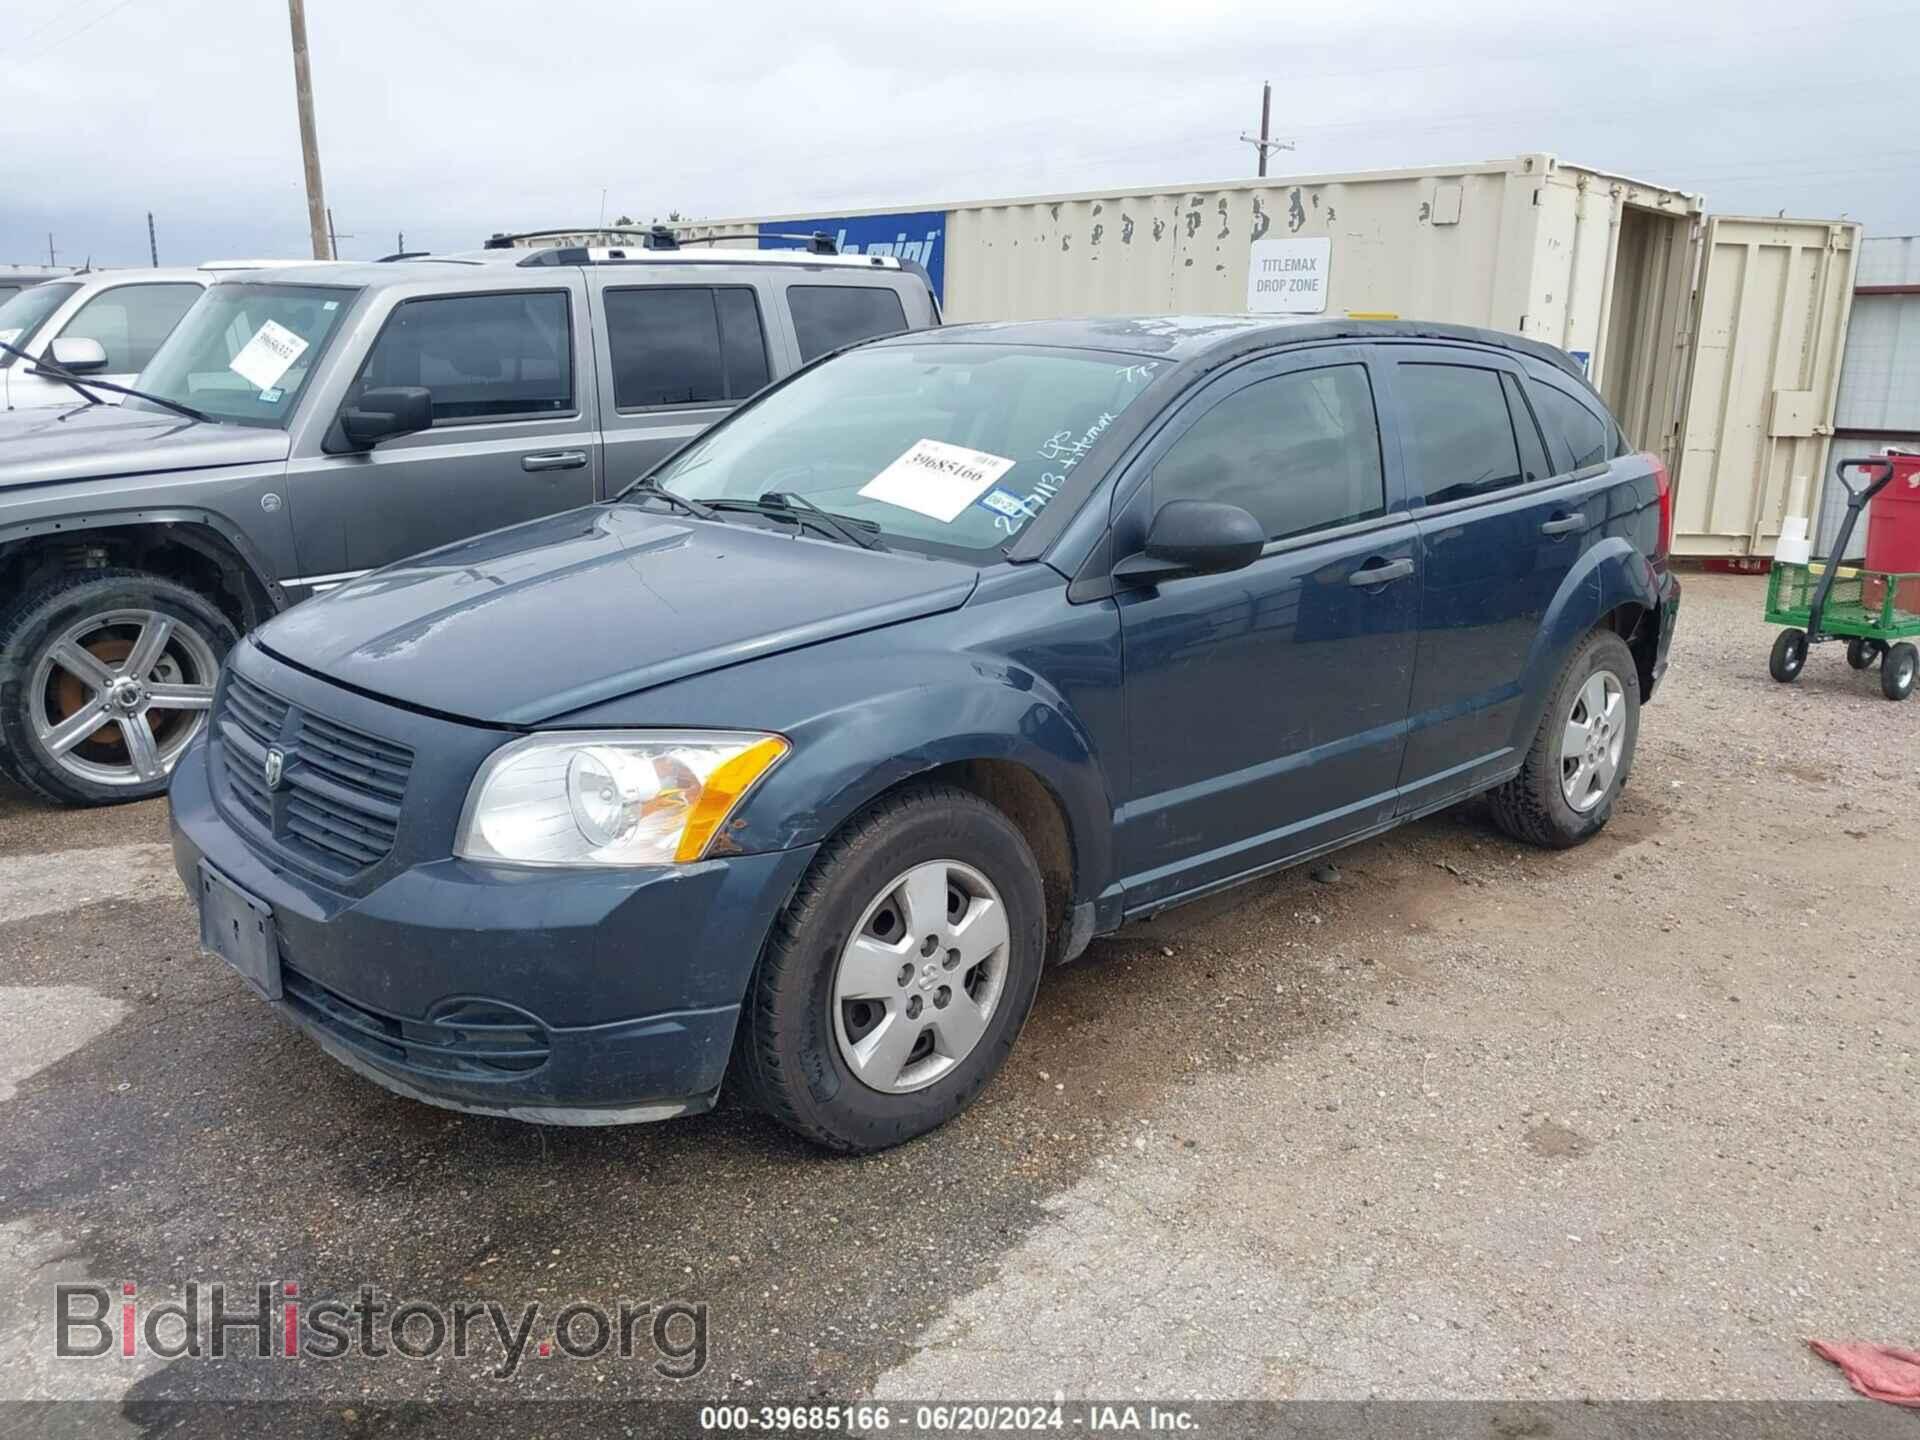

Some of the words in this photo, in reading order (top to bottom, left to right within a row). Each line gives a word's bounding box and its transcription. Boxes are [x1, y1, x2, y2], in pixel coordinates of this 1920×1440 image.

[1262, 258, 1317, 272] TITLEMAX
[1256, 279, 1287, 292] DROP
[1289, 278, 1320, 292] ZONE
